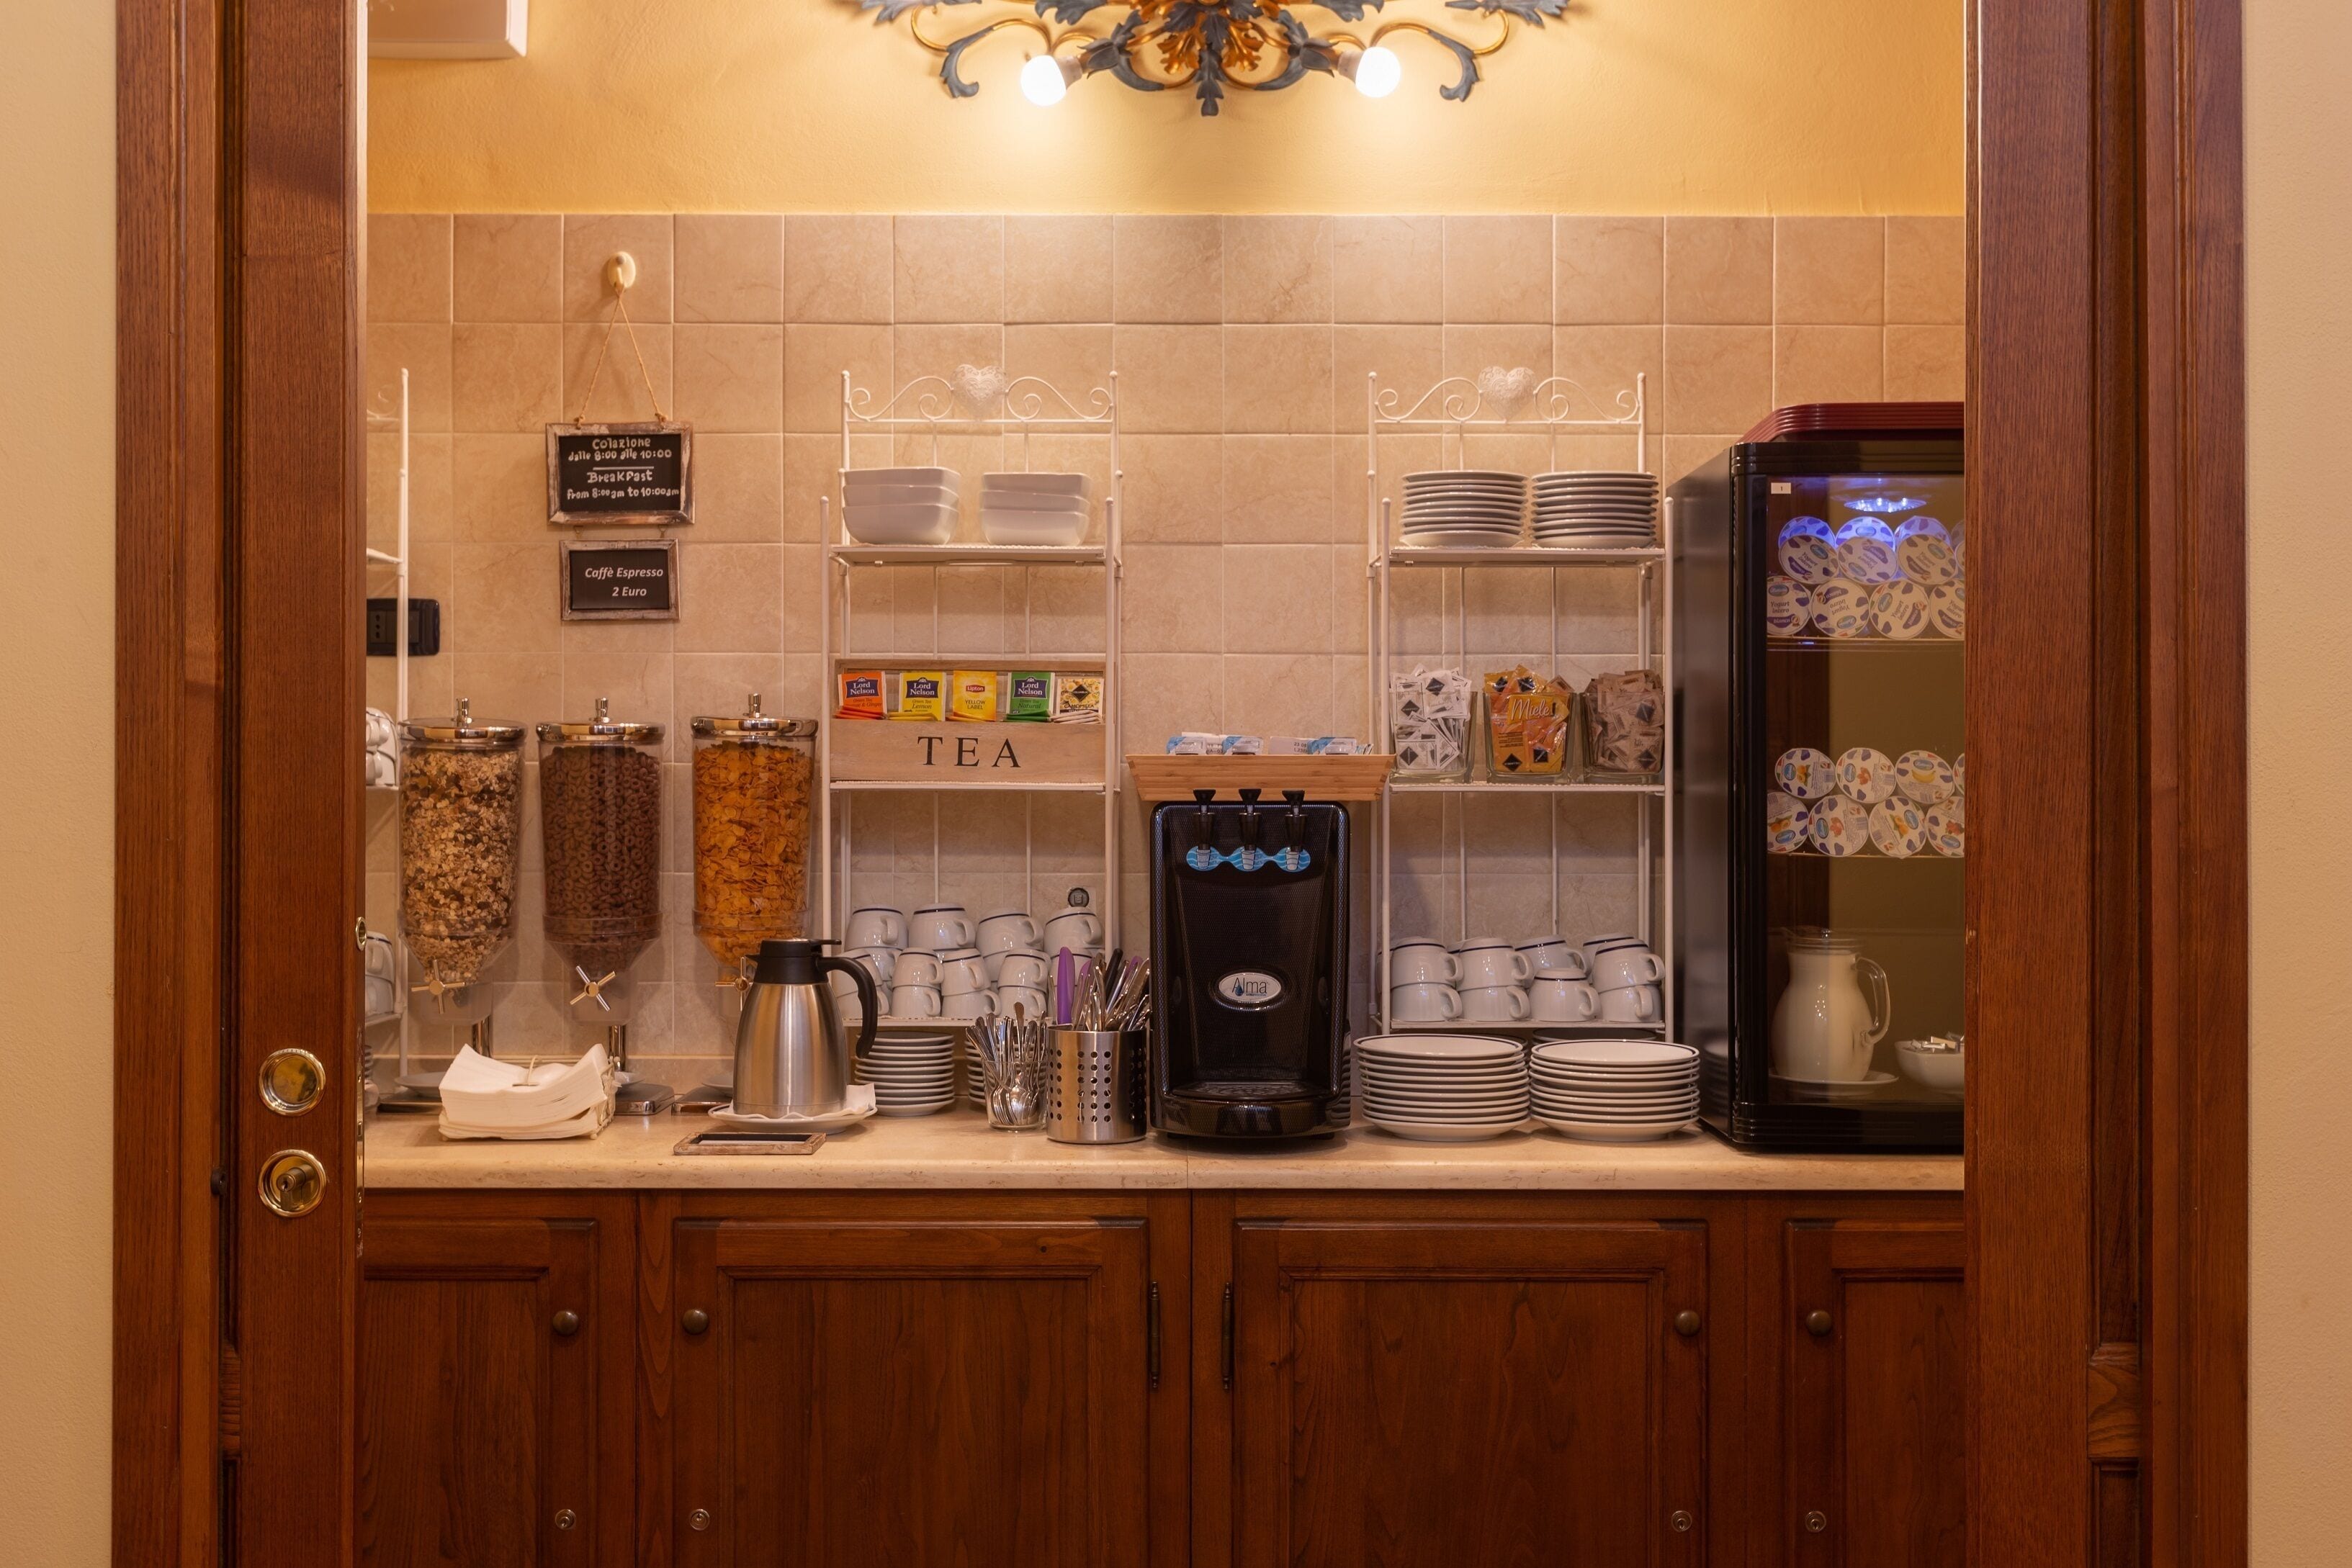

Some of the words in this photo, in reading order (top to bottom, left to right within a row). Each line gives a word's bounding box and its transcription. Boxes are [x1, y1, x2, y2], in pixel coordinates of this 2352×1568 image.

[592, 436, 651, 450] Colazione
[568, 450, 591, 461] dalle
[594, 450, 617, 461] 8:00
[620, 448, 637, 460] alle
[640, 449, 672, 459] 10:00
[627, 486, 639, 497] to
[585, 567, 614, 580] Caffè
[616, 567, 664, 580] Espresso
[611, 586, 619, 597] 2
[621, 586, 647, 597] Euro
[1510, 698, 1550, 721] Miele
[917, 736, 1021, 768] TEA
[1231, 977, 1269, 994] Alma
